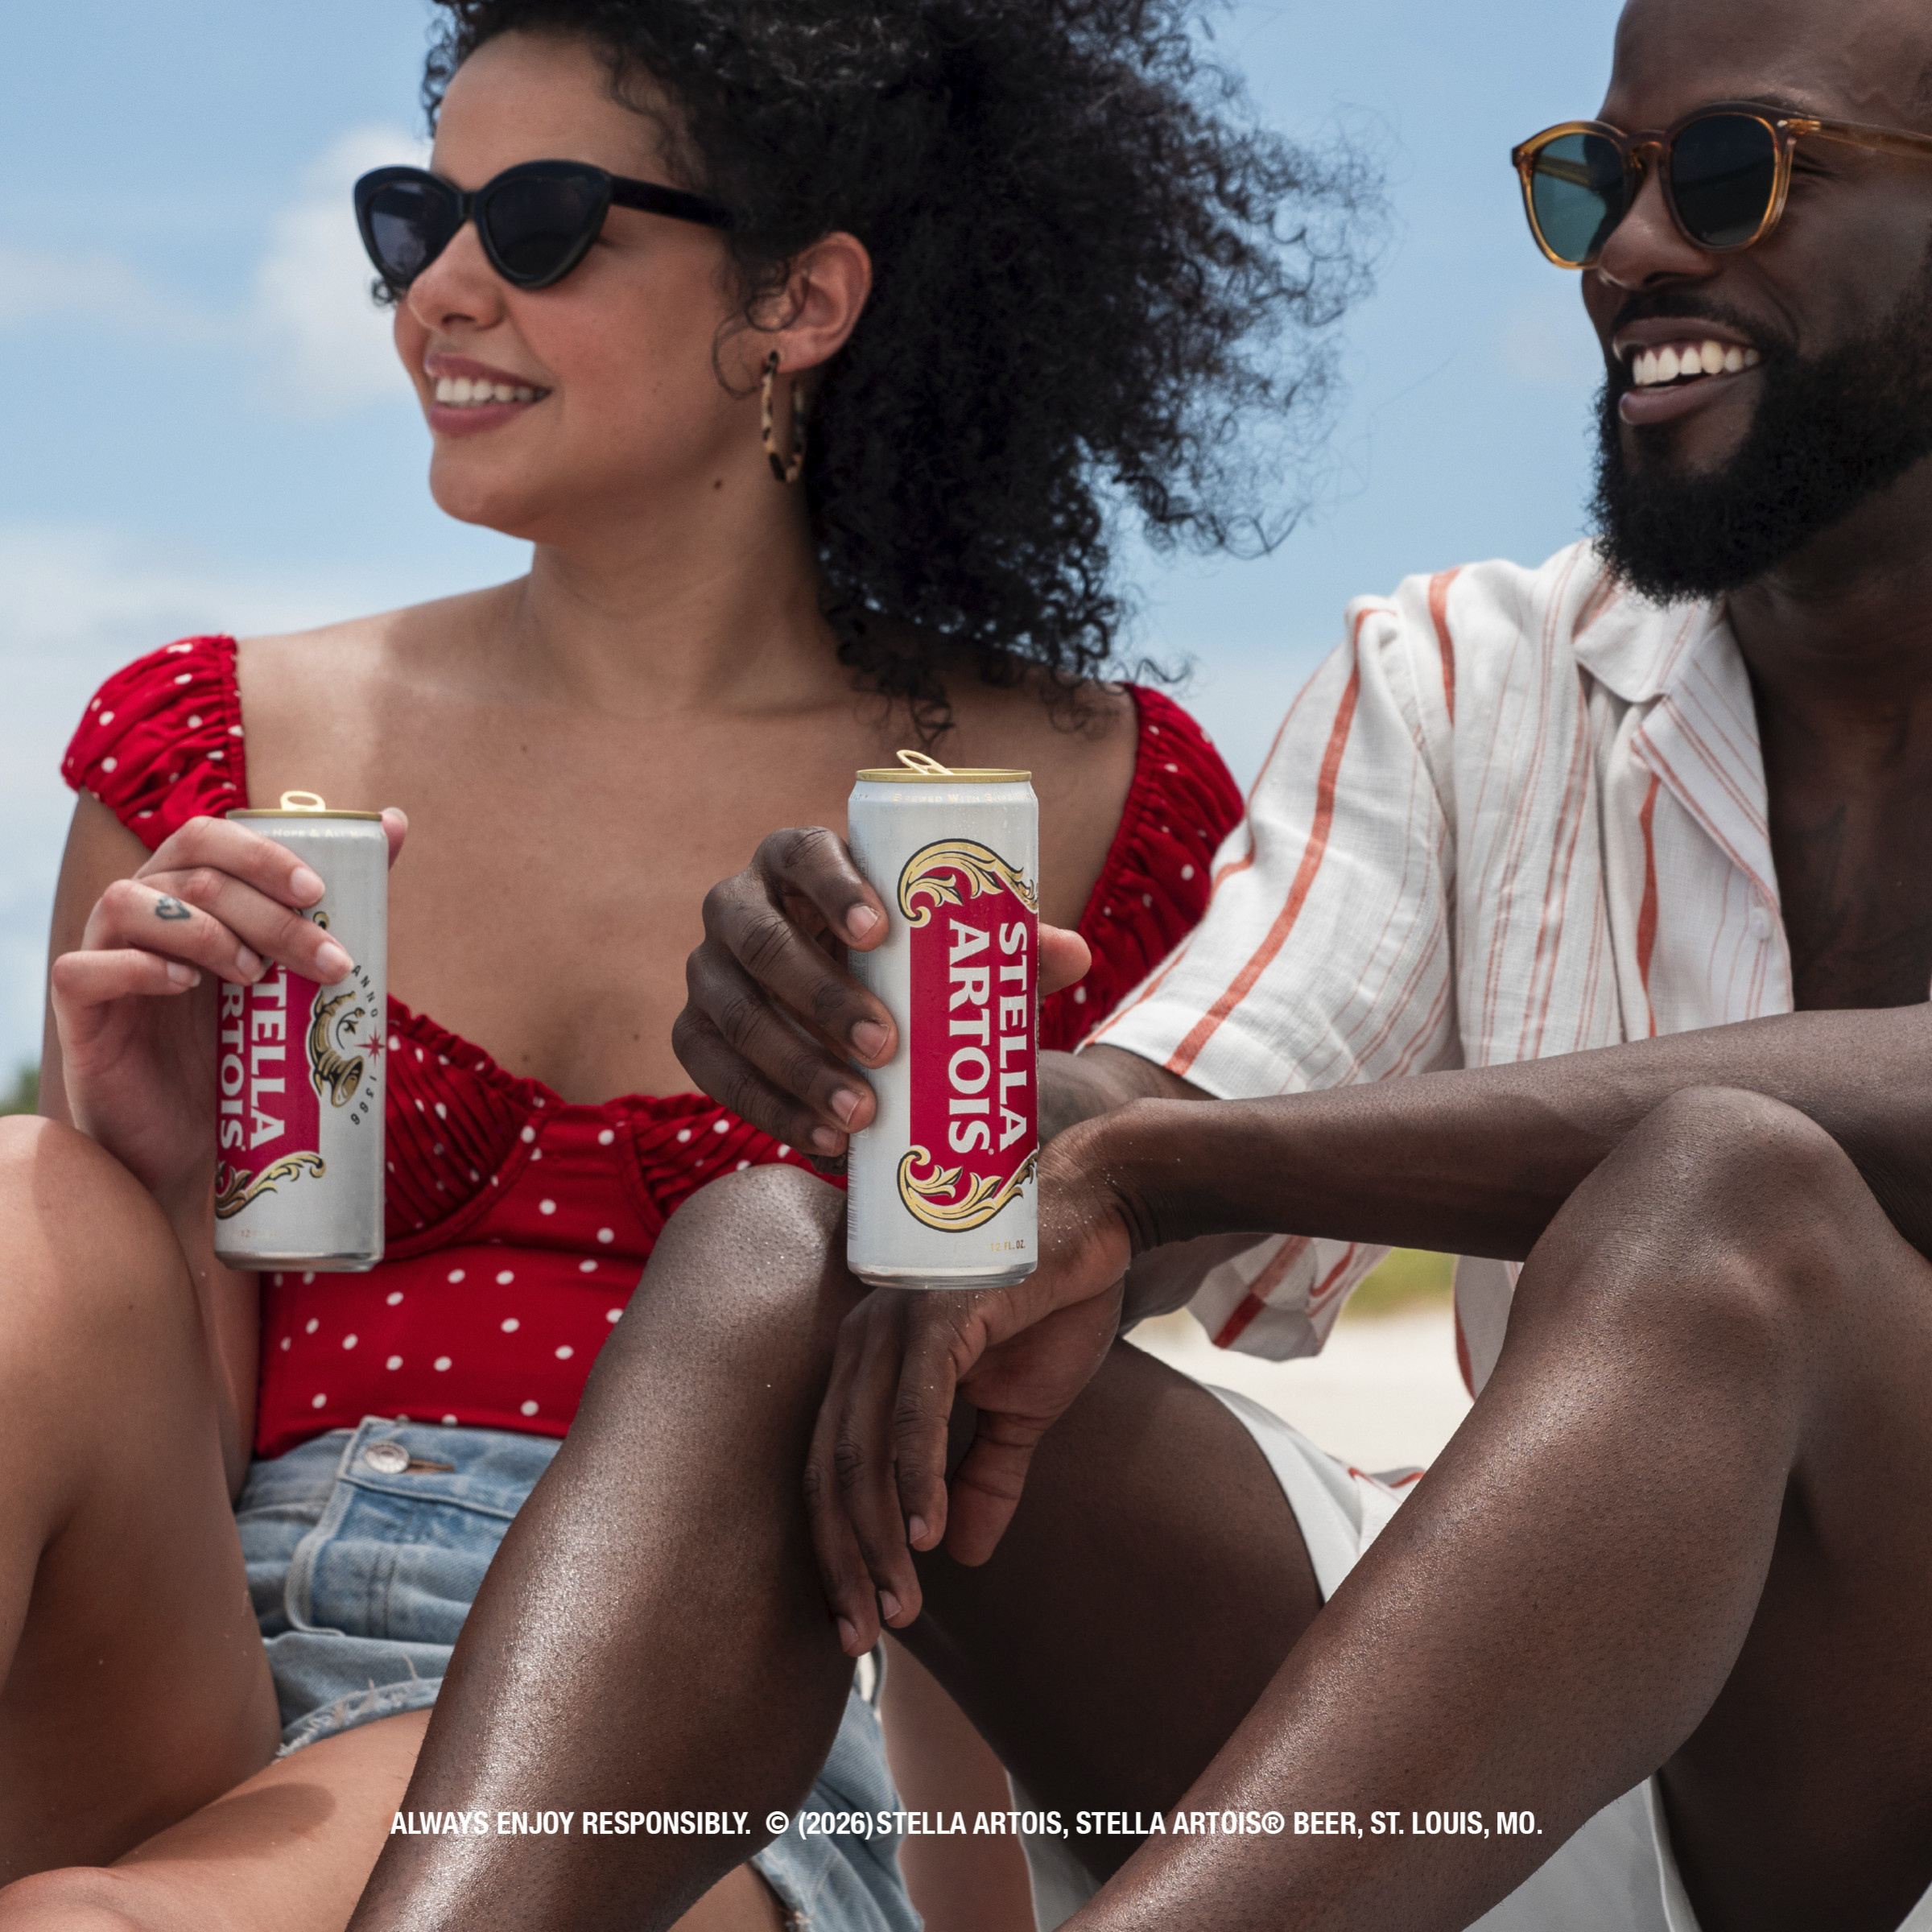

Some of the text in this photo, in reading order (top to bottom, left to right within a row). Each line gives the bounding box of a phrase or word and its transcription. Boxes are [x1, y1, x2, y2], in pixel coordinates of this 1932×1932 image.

[351, 965, 379, 1018] ANNO
[999, 921, 1028, 1153] STELLA
[220, 982, 246, 1151] RTOIS
[250, 964, 287, 1150] TELLA
[349, 1074, 378, 1125] 1566
[990, 1242, 1001, 1252] 12
